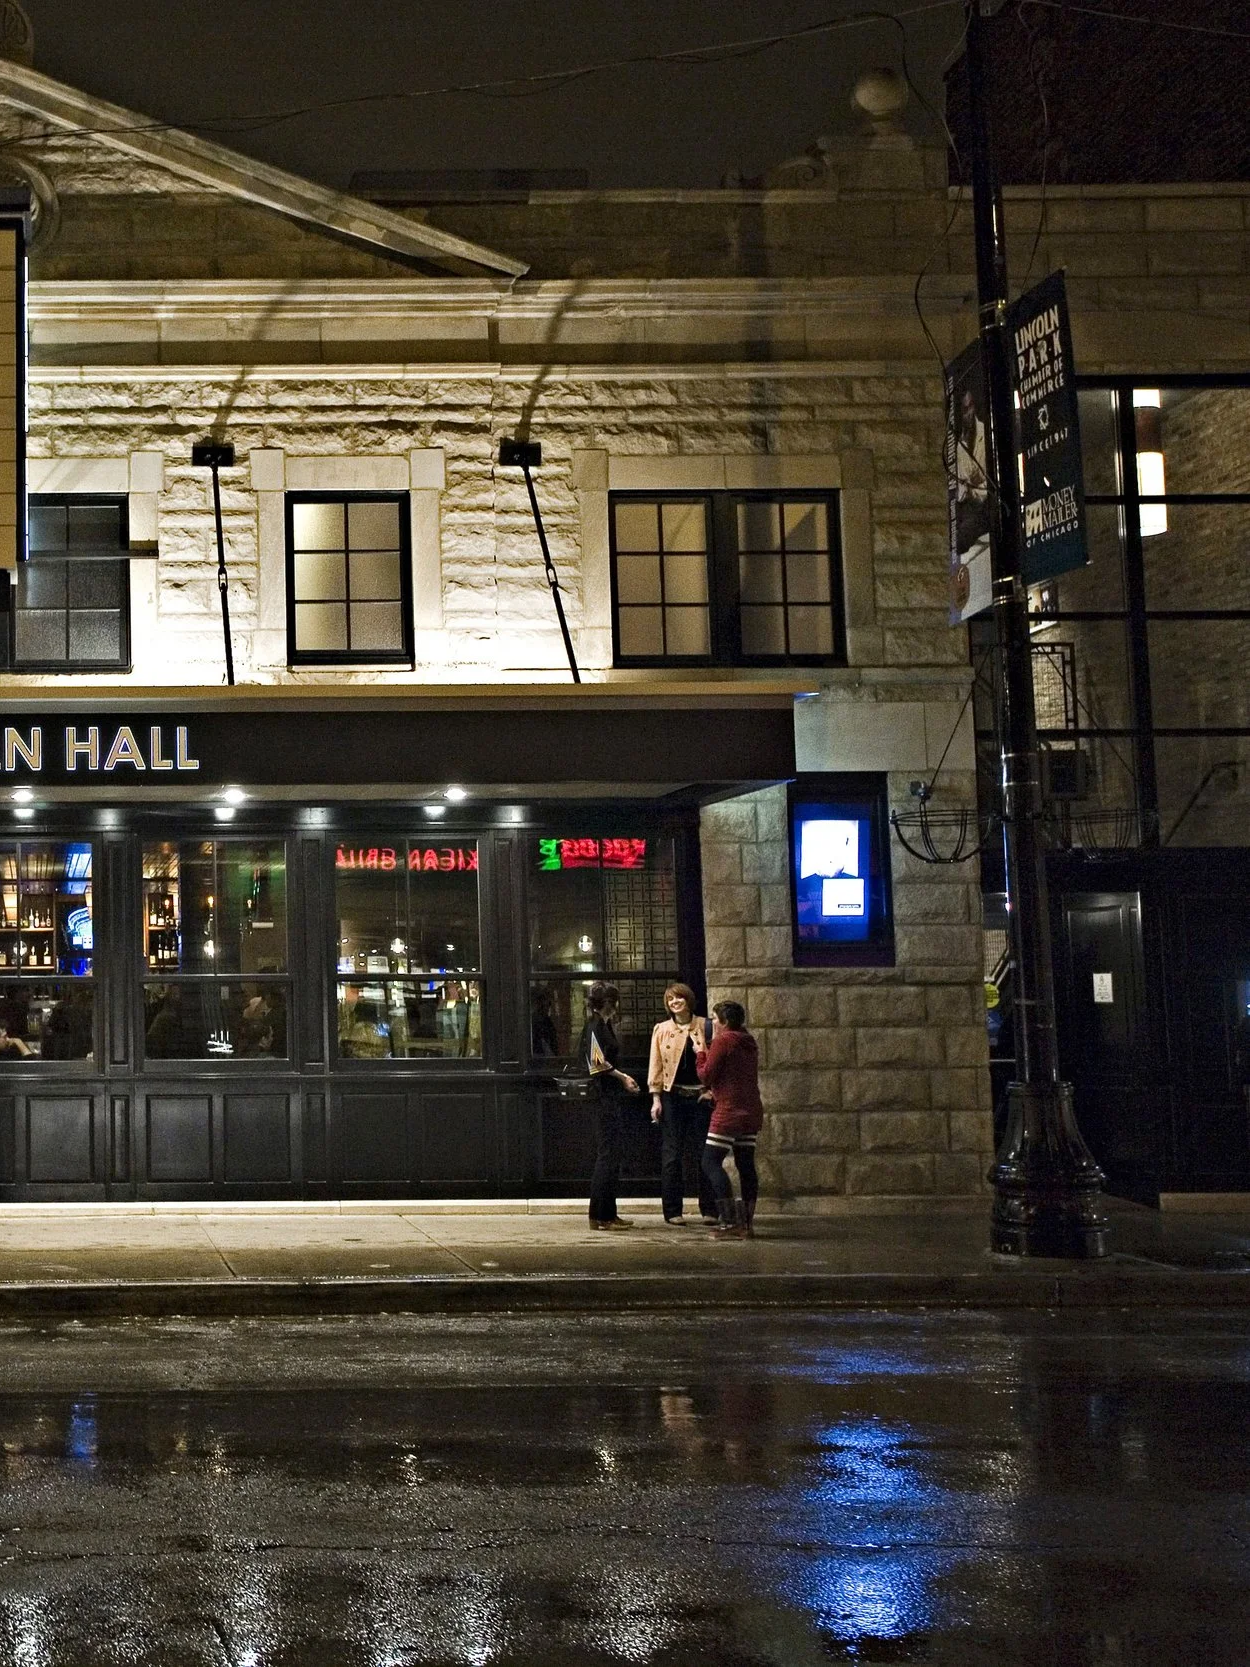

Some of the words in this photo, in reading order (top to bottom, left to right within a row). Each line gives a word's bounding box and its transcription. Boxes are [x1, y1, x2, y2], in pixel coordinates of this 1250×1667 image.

[1014, 304, 1059, 355] LINCOLN
[1020, 365, 1051, 395] CHAMBER
[1053, 357, 1063, 373] OF
[1021, 373, 1064, 409] COMMERCE
[1042, 484, 1075, 513] MONEY
[1042, 501, 1078, 531] MAILER
[1026, 537, 1036, 548] OF
[1040, 520, 1079, 543] CHICAGO
[65, 726, 200, 771] HALL
